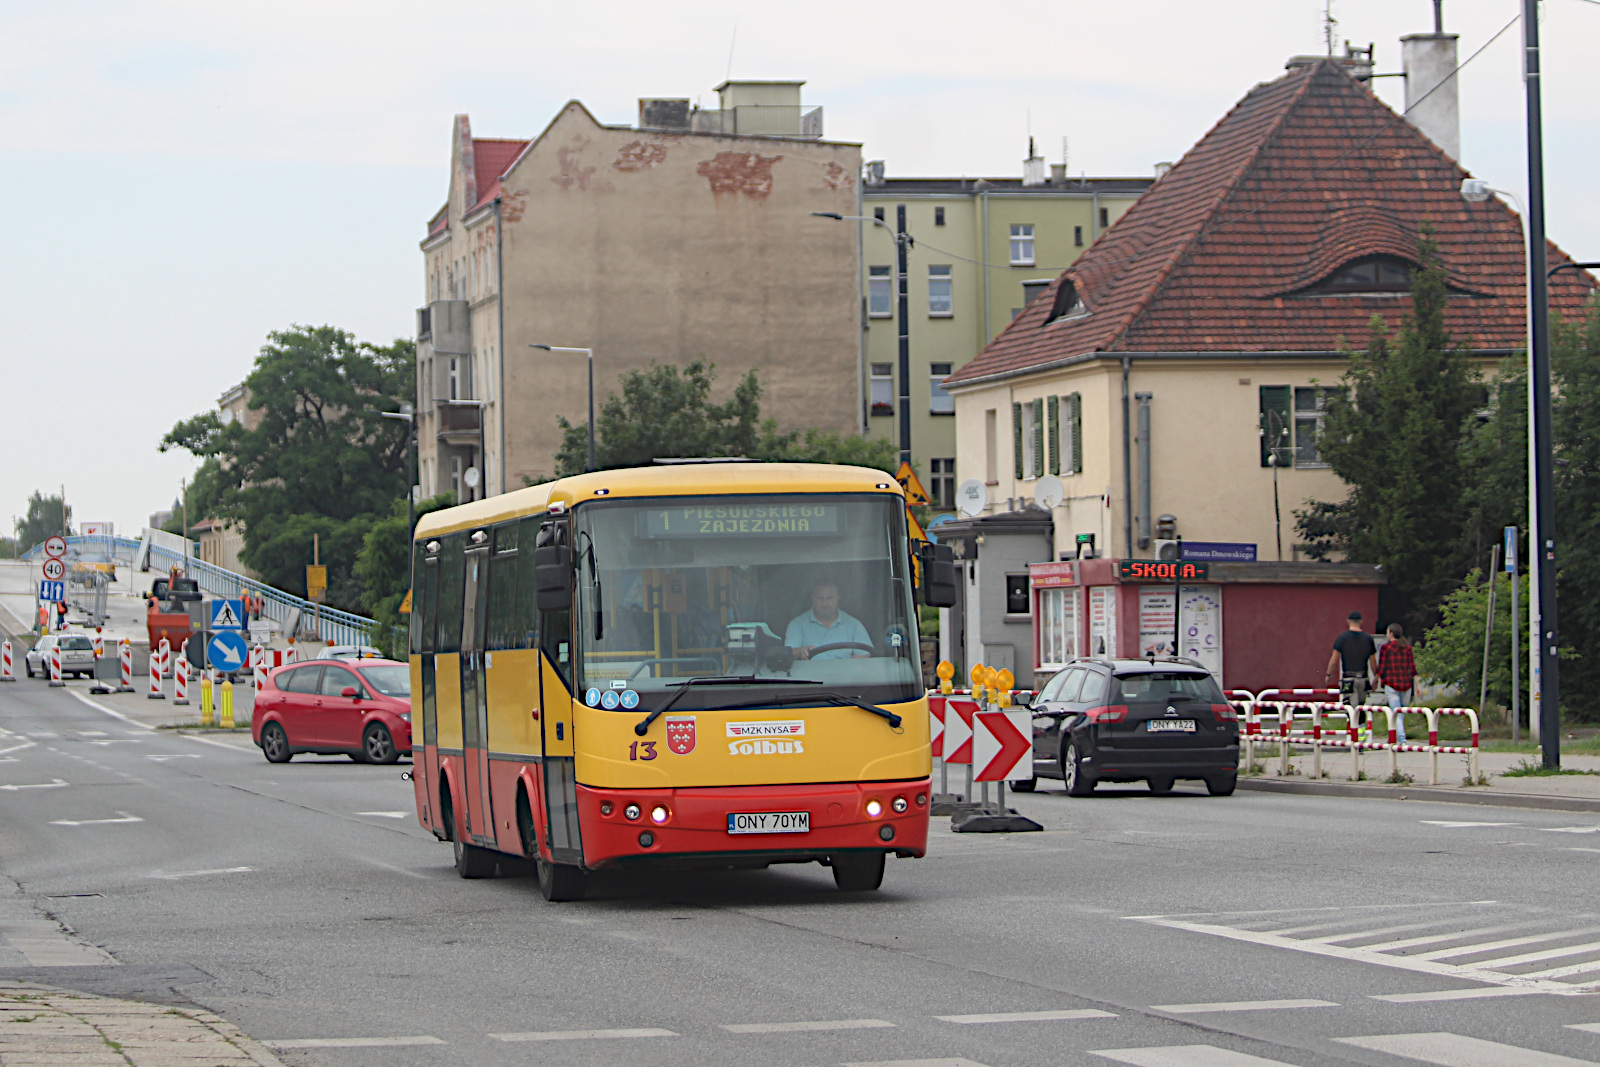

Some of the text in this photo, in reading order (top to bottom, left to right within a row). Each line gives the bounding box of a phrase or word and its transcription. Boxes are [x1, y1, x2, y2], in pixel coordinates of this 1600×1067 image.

[965, 486, 979, 495] 4K
[659, 510, 669, 530] 1
[699, 519, 809, 532] ZAJEZDNIA
[1183, 549, 1254, 559] Romana Dmowskiego
[46, 564, 62, 575] 40
[741, 726, 789, 735] MZK NYSA
[1152, 721, 1194, 729] ONY YA22
[629, 741, 658, 761] 13
[728, 737, 804, 756] Solbus
[737, 814, 807, 829] ONY 70YM
